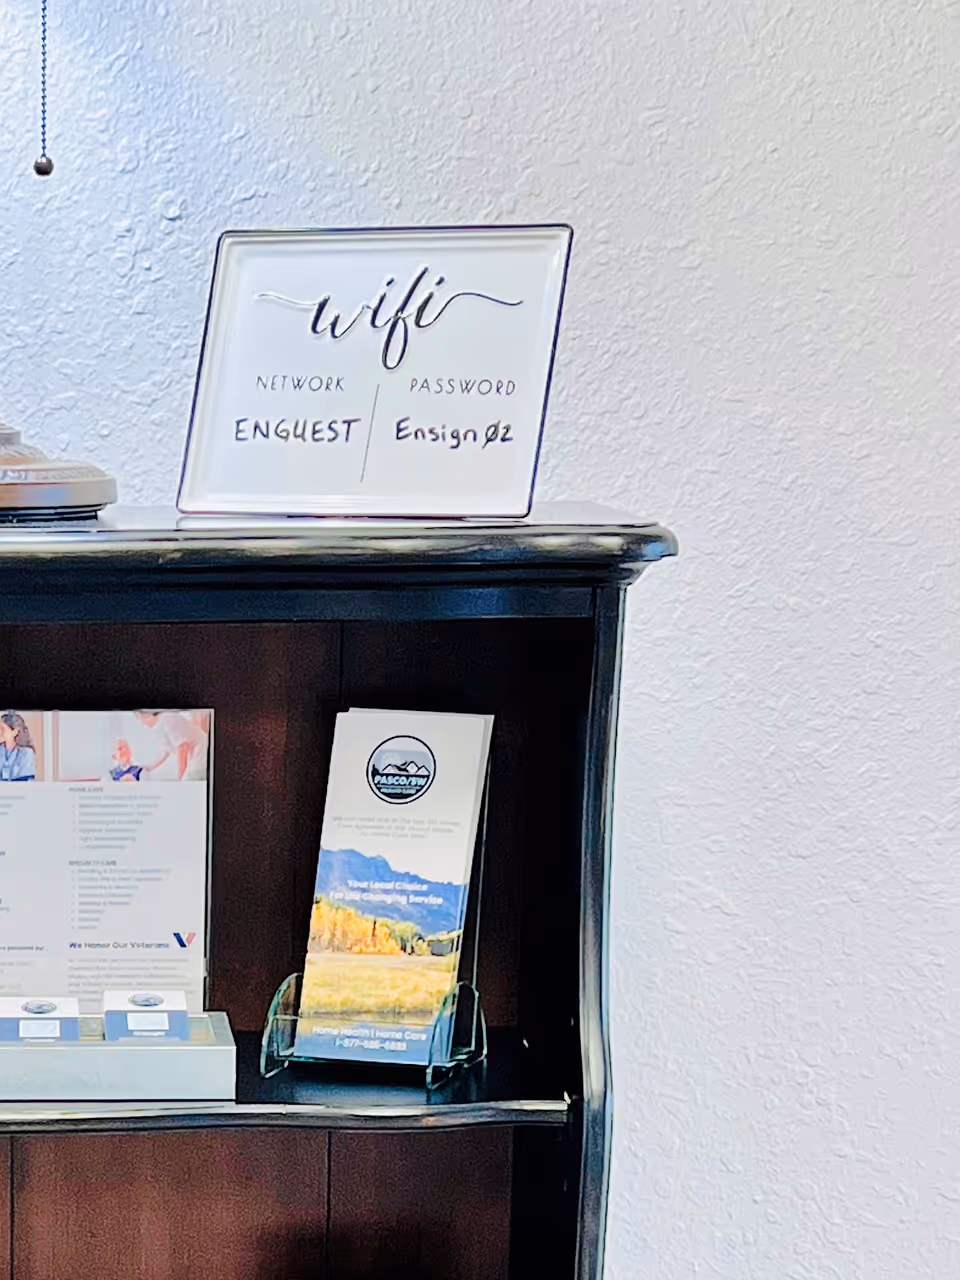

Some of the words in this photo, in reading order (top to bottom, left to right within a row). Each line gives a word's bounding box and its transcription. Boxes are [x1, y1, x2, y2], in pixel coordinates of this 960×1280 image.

[275, 266, 502, 370] wifi
[256, 375, 345, 392] NETWORK
[410, 378, 516, 396] PASSWORD
[234, 417, 362, 443] ENGUEST
[69, 941, 82, 949] We
[84, 941, 110, 949] Honor
[112, 941, 128, 949] Our
